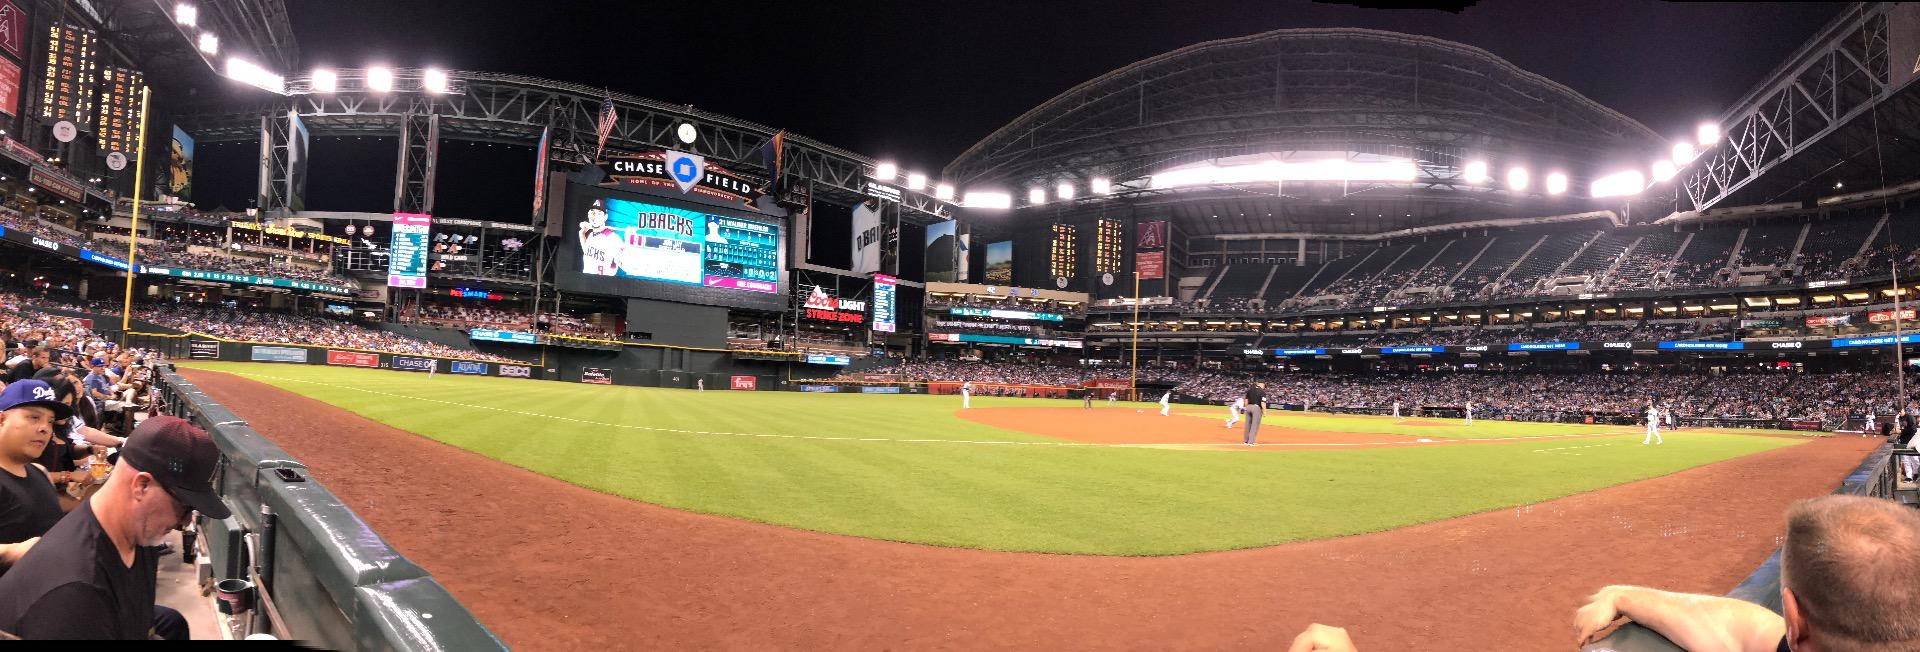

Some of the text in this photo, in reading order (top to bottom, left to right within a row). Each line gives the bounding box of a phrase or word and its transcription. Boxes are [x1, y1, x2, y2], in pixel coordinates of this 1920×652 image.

[614, 161, 751, 194] CHASE FIELD
[33, 237, 53, 249] CHASE
[838, 299, 866, 312] LIGHT
[806, 309, 864, 323] STRIKE ZONE
[399, 359, 424, 368] CHASE
[499, 364, 531, 377] GEICO
